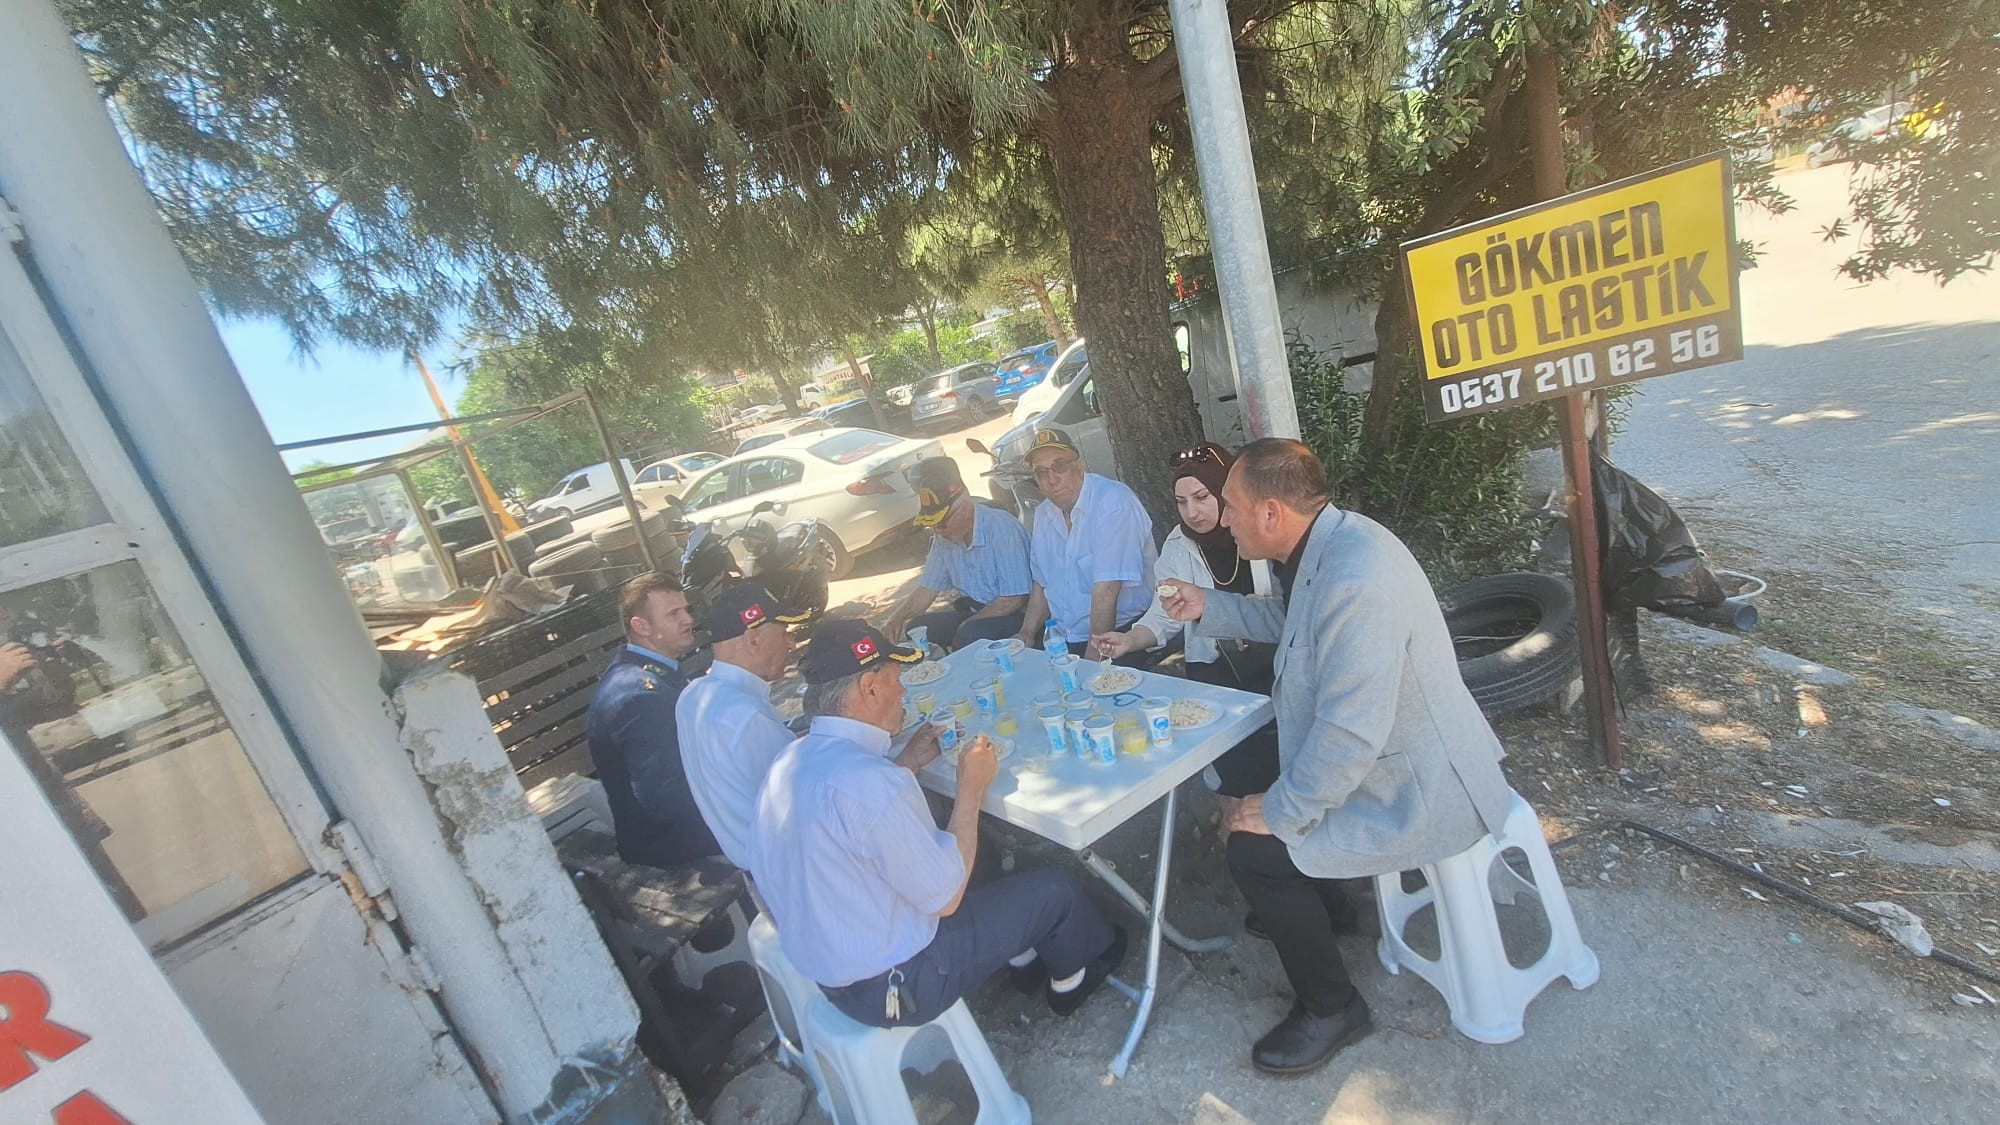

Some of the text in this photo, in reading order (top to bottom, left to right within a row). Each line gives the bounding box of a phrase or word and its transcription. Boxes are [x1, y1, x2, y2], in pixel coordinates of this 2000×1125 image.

[1455, 200, 1665, 306] GÖKMEN
[1432, 251, 1716, 369] OTO LASTİK
[1440, 325, 1720, 414] 0537 210 62 56
